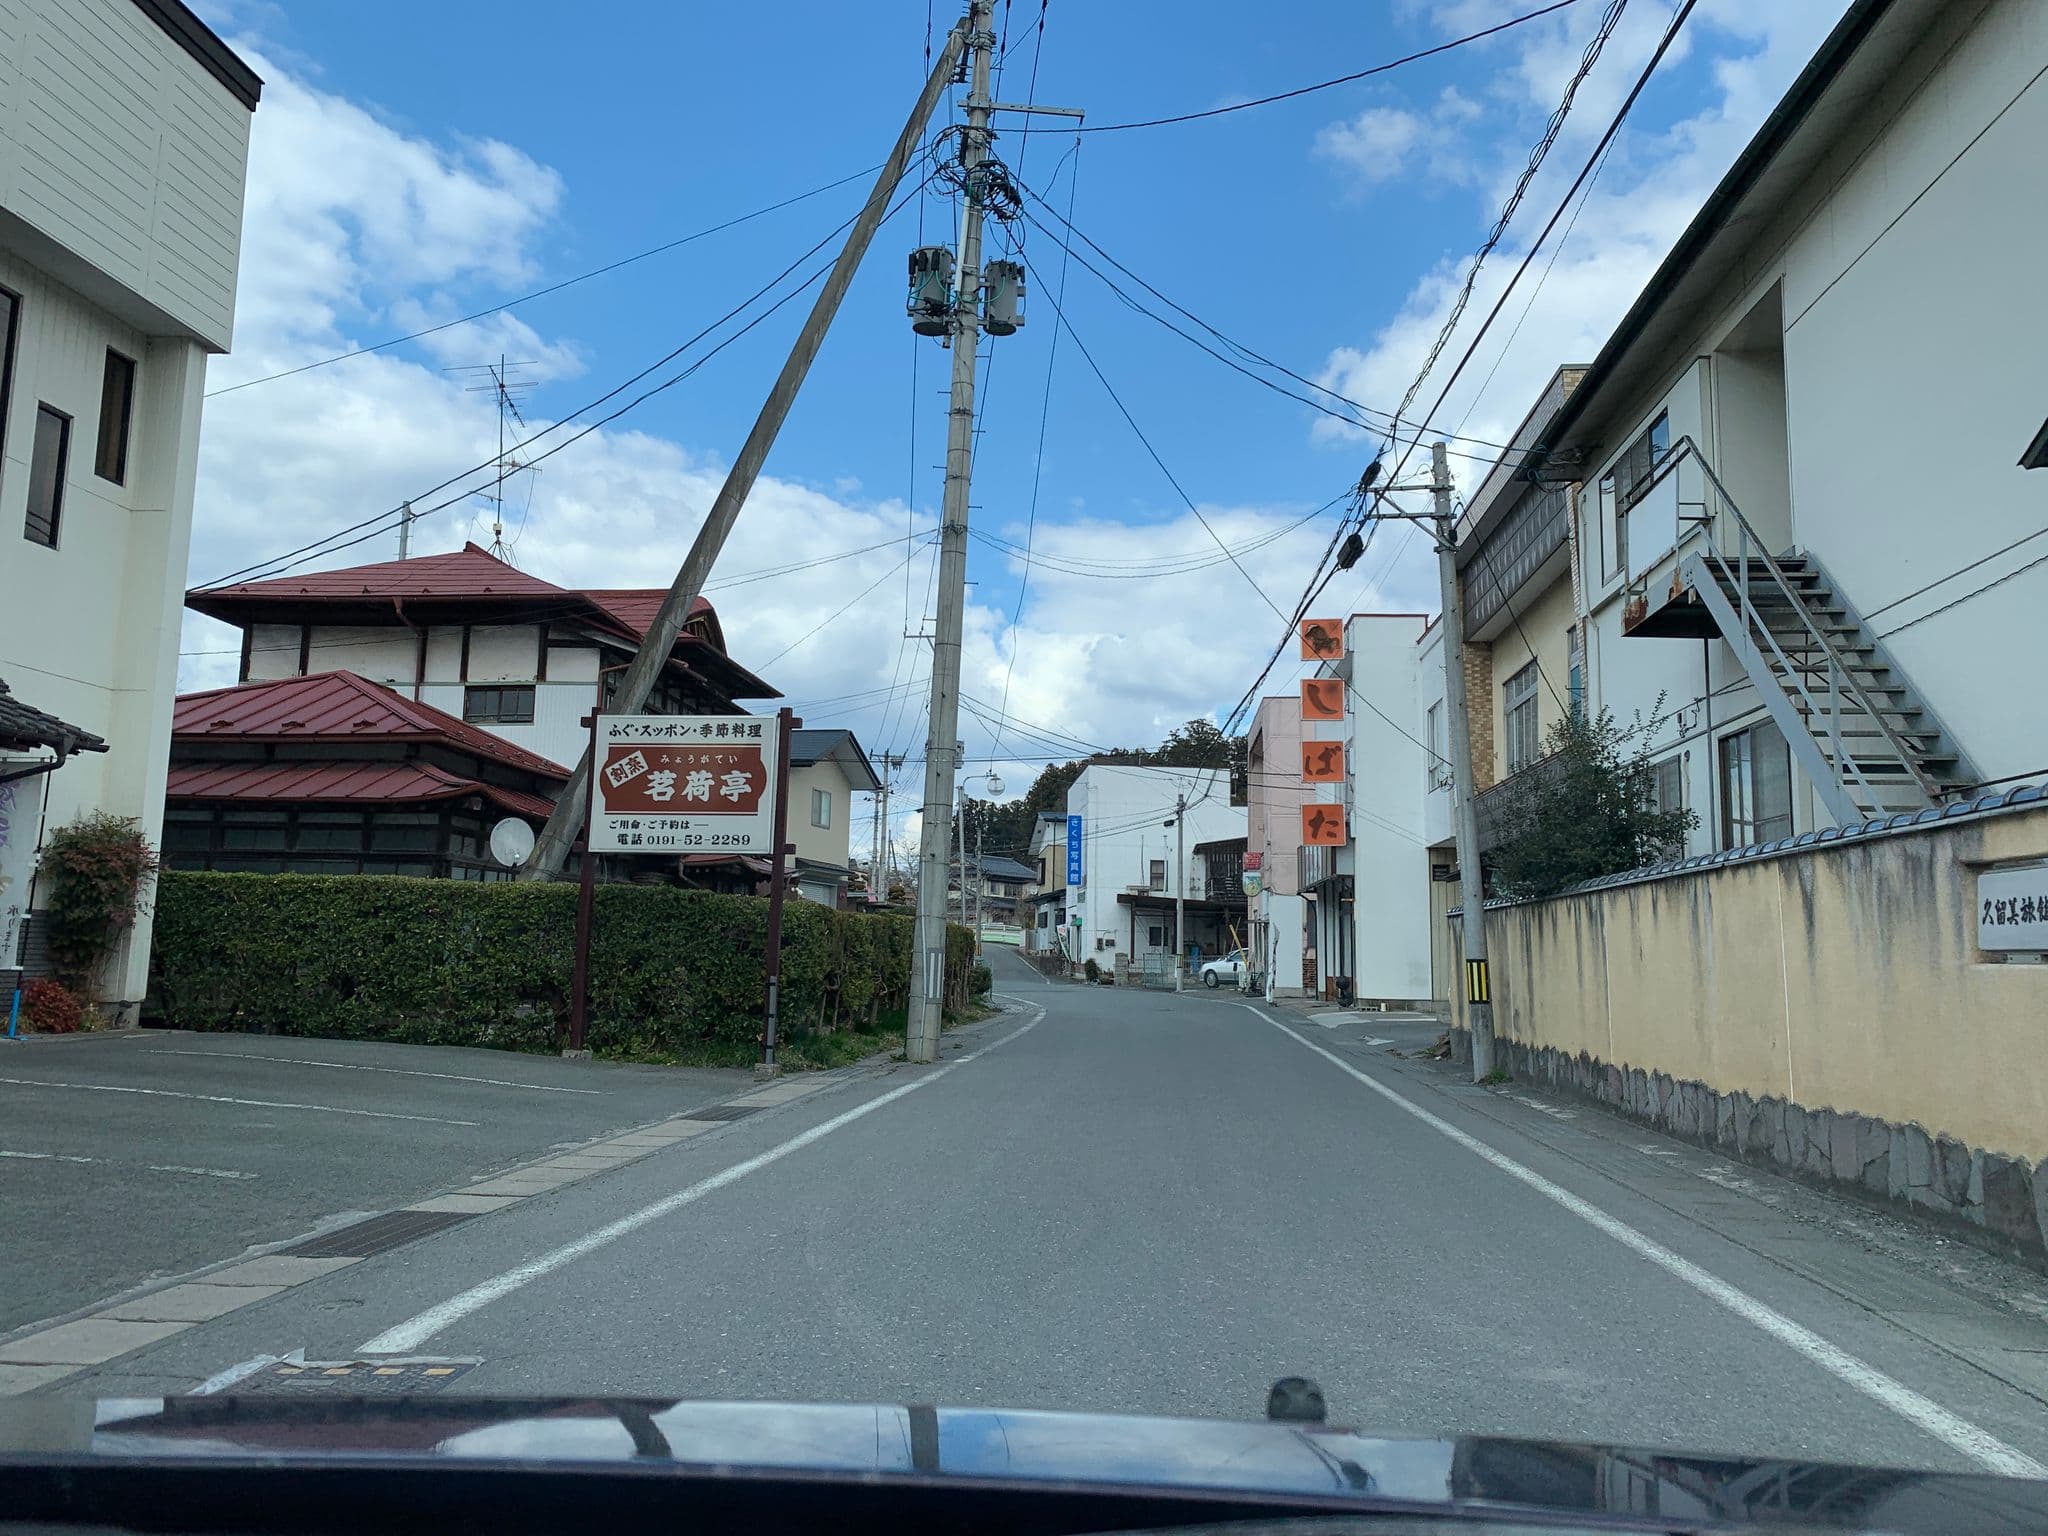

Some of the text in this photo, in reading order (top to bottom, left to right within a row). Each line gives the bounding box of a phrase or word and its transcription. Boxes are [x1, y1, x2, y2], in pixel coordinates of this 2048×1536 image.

[608, 723, 762, 738] ふぐ・スッポン・季節料理
[660, 754, 738, 764] みょうがてい
[643, 769, 752, 802] 茗荷亭
[647, 834, 751, 846] 0191-52-2289
